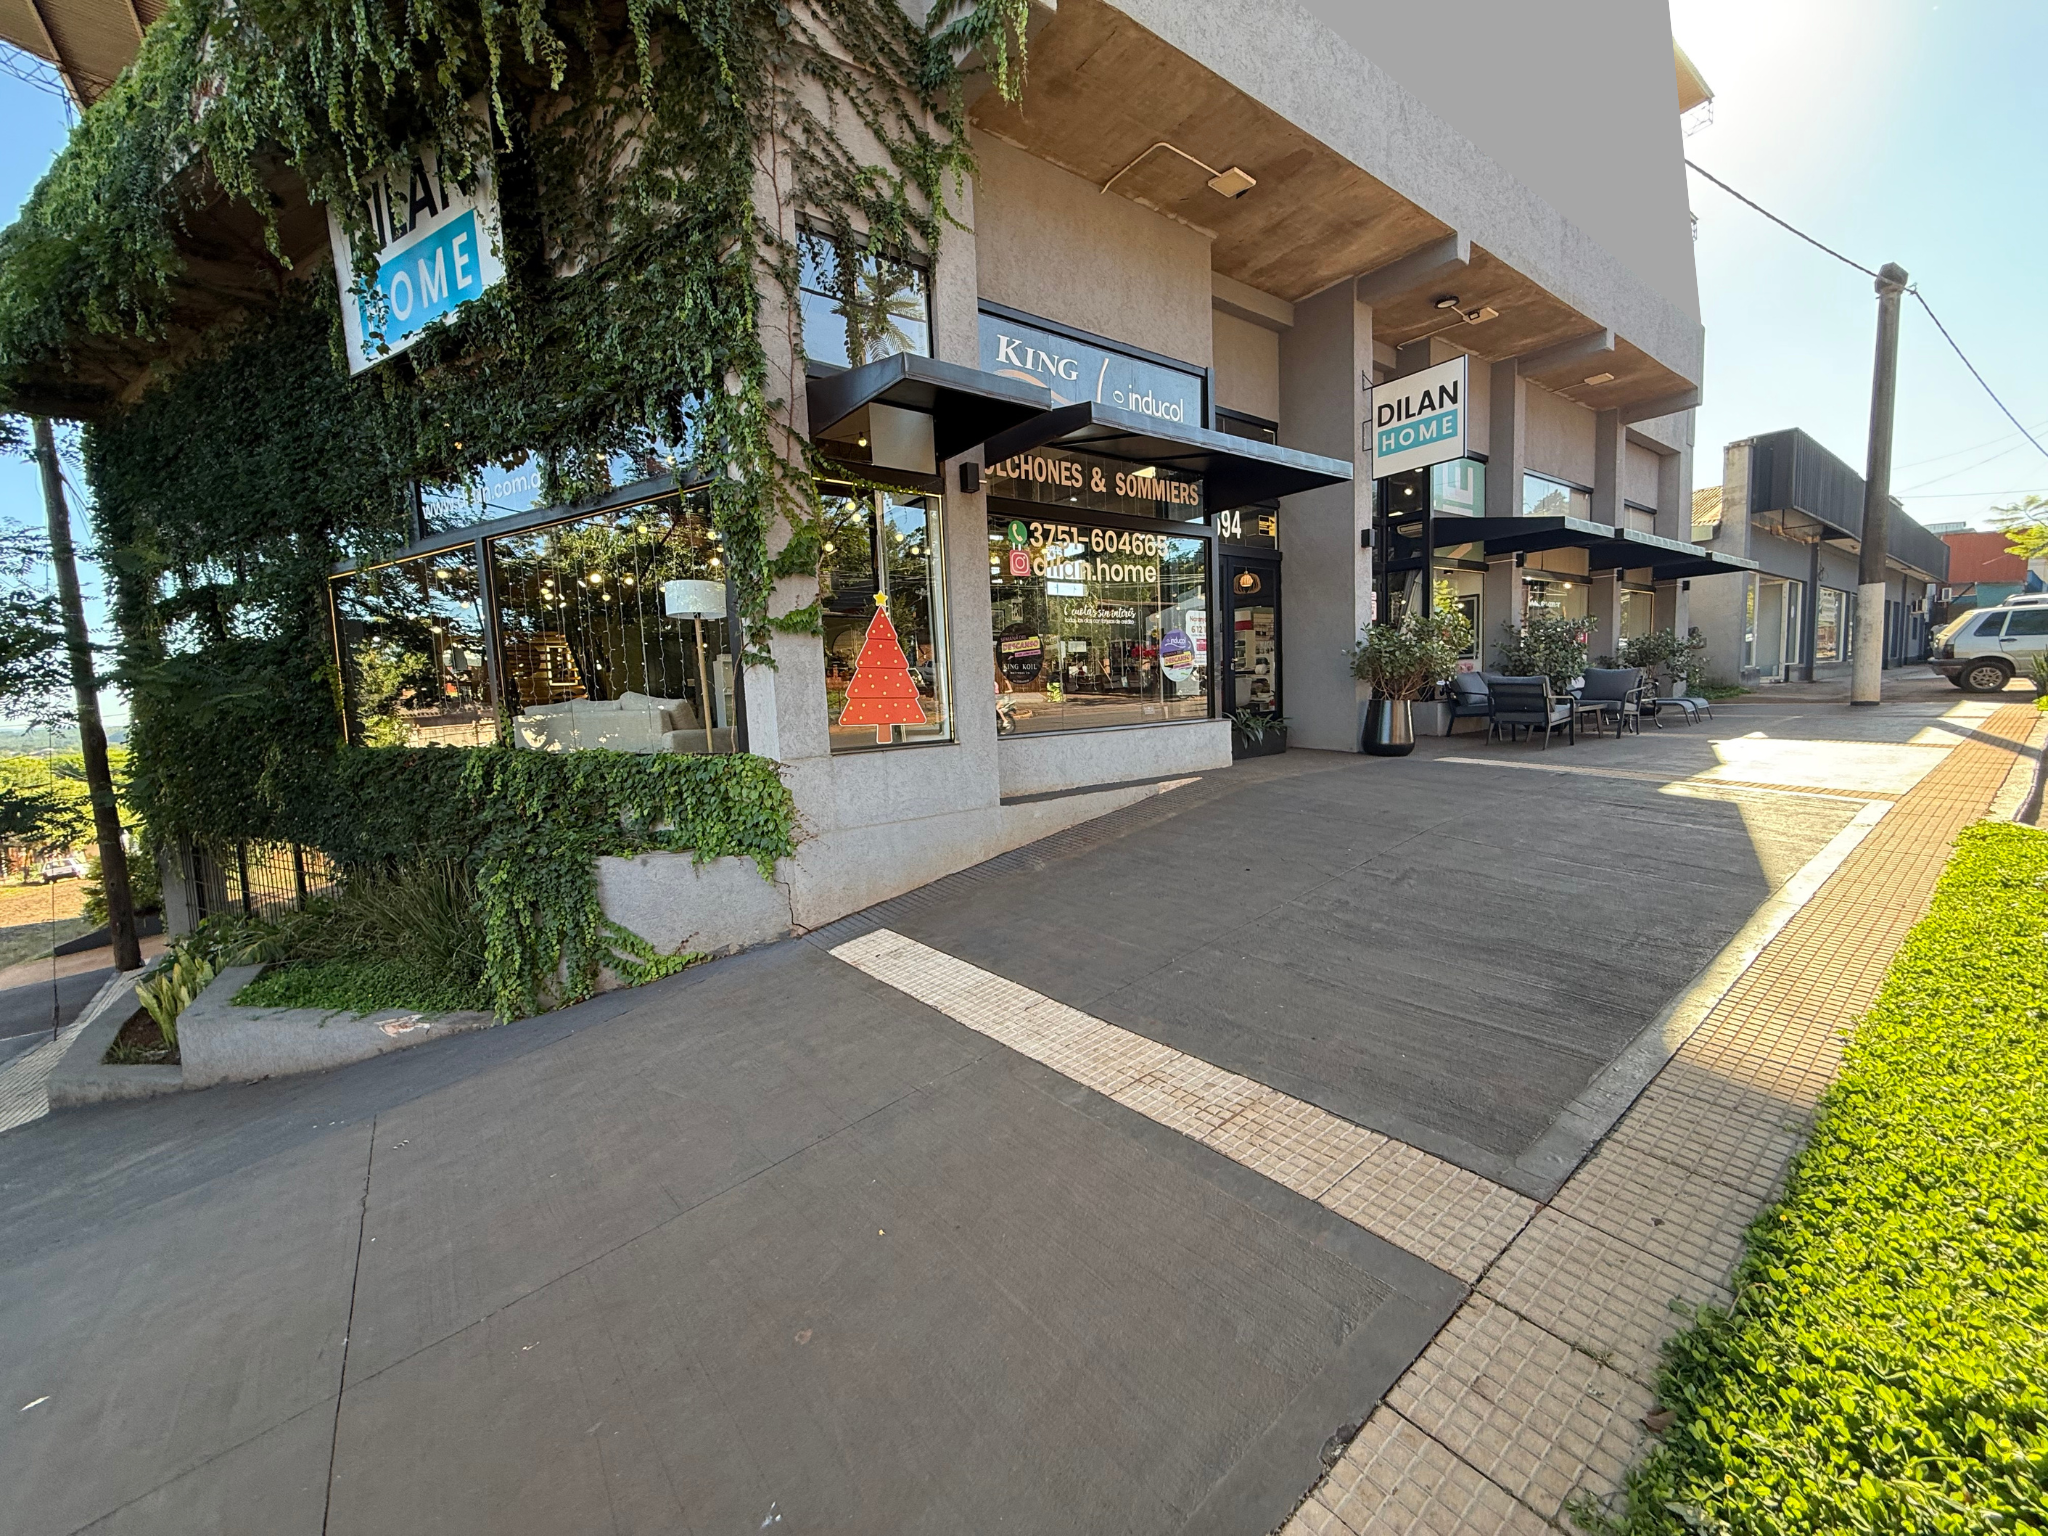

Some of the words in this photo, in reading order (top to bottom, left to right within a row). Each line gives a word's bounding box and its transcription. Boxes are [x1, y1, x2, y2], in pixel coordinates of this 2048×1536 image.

[996, 334, 1079, 381] KING
[1128, 384, 1184, 423] inducol
[1378, 380, 1458, 428] DILAN
[1382, 415, 1453, 452] HOME
[1091, 467, 1106, 493] &
[1116, 472, 1199, 506] SOMMIERS
[1030, 522, 1168, 557] 3751-604665
[1033, 557, 1157, 582] dilan.home
[1003, 640, 1039, 651] DESCANSO
